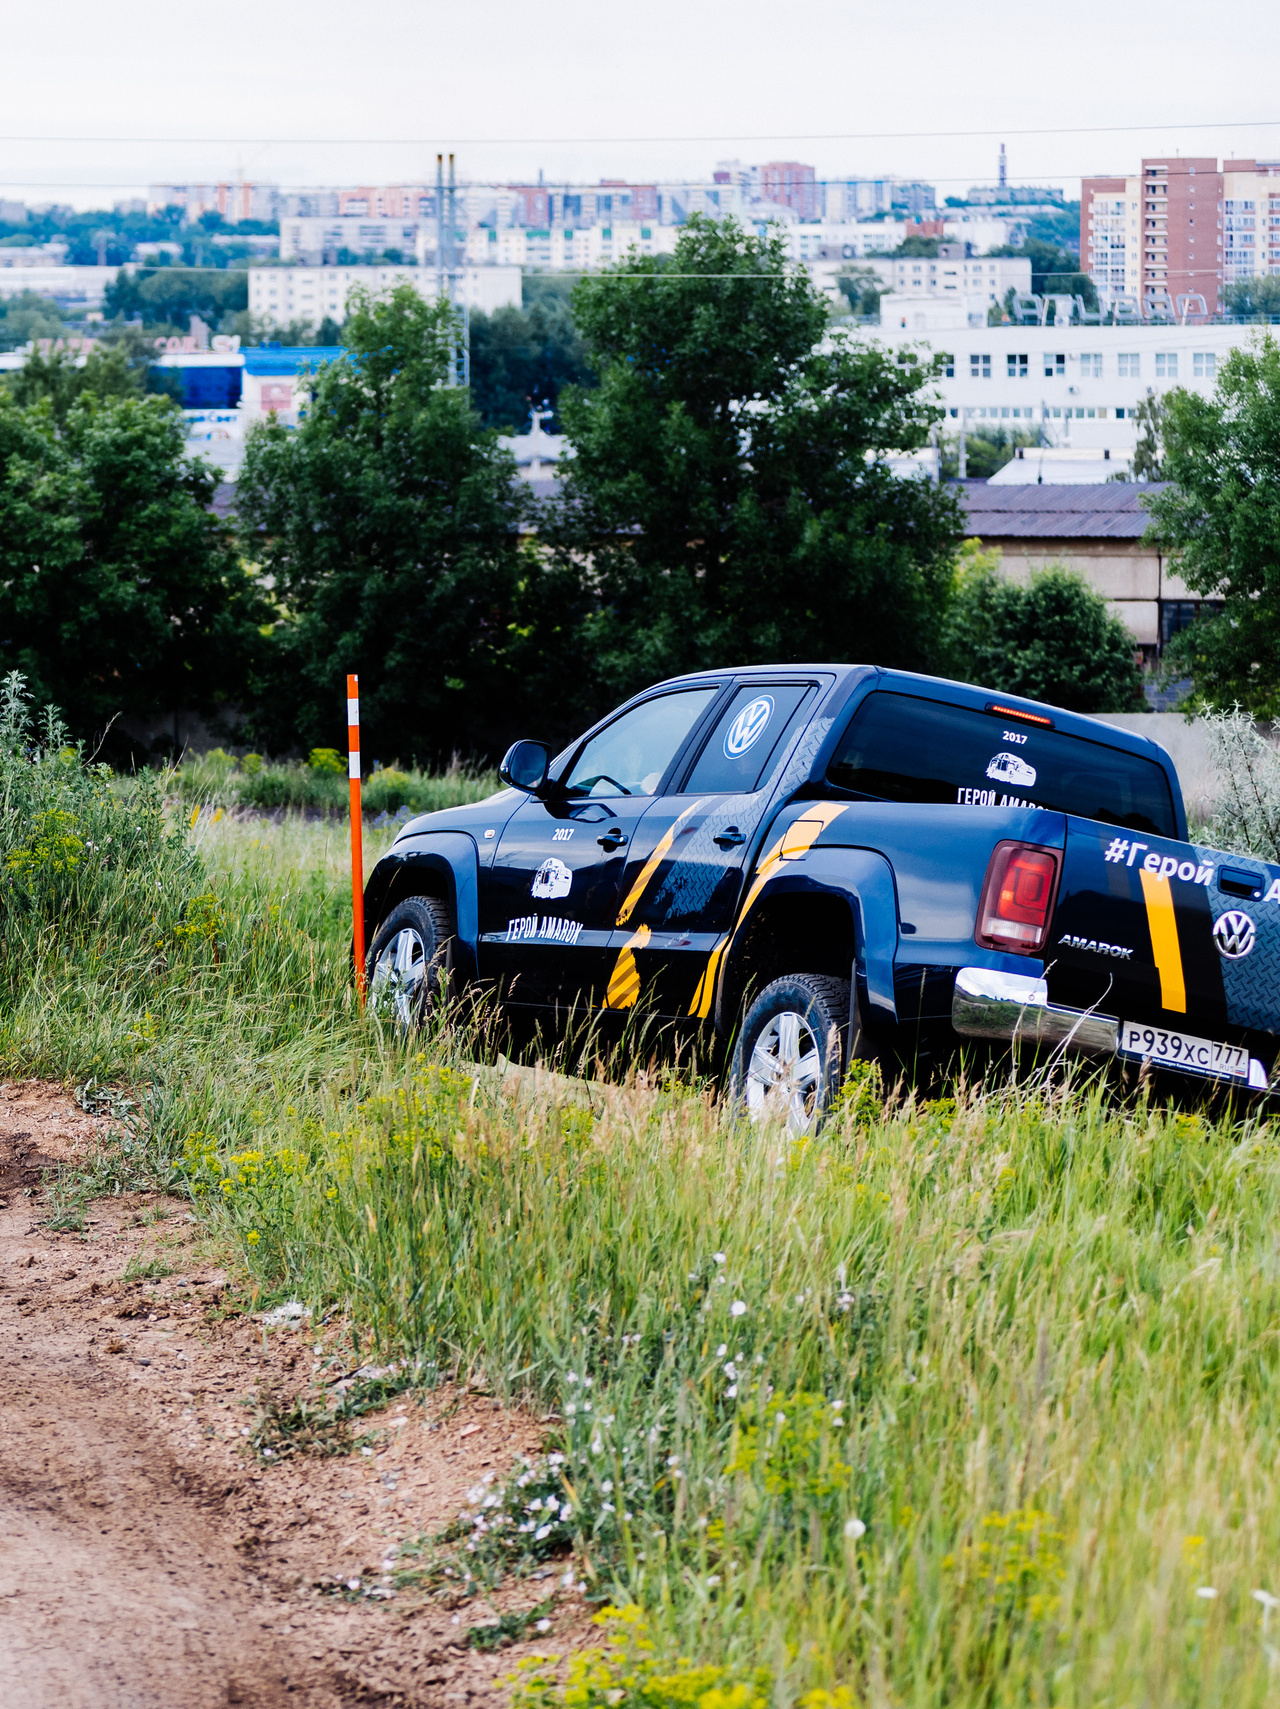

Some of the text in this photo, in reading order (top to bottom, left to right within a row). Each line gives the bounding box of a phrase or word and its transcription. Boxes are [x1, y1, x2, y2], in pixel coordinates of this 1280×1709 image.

[1002, 730, 1028, 745] 2017
[957, 787, 997, 807] ГЕРОЙ
[552, 828, 575, 841] 2017
[1104, 837, 1215, 887] #Герой
[505, 912, 584, 945] ГЕРОЙ AMAROK
[1058, 934, 1134, 961] AMAROK
[1213, 1043, 1243, 1067] 777
[1220, 1063, 1235, 1073] RUS
